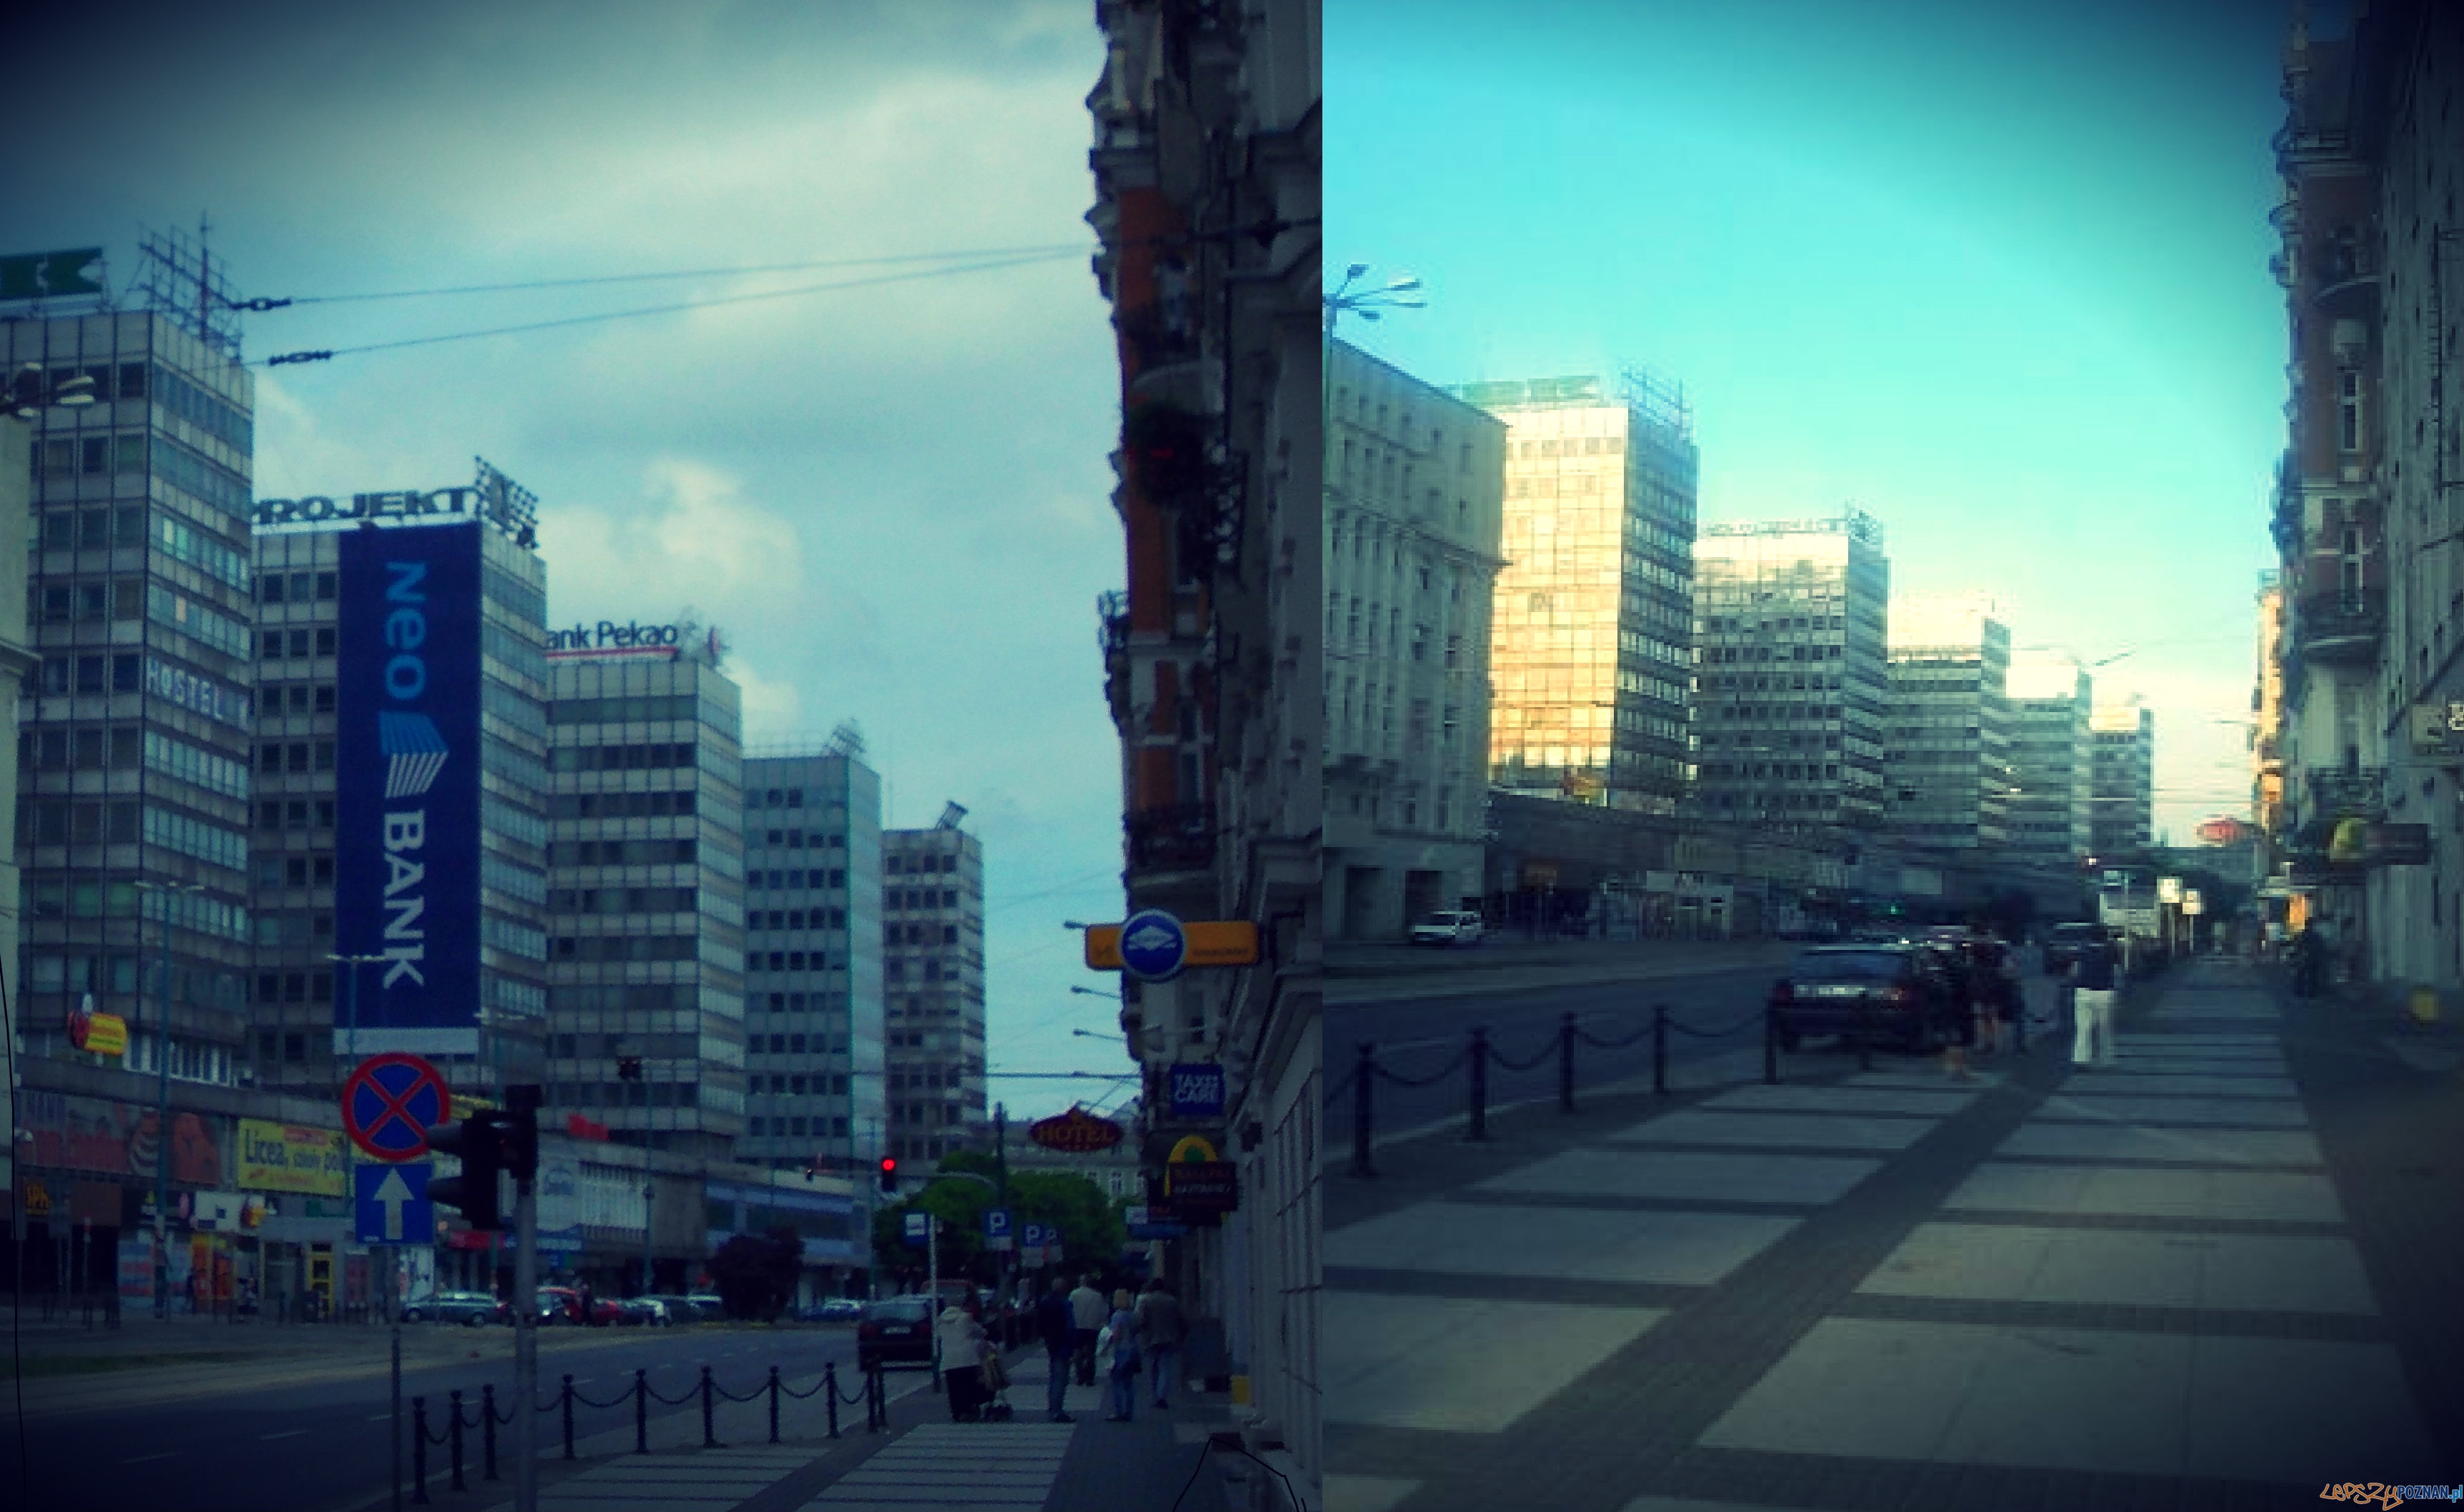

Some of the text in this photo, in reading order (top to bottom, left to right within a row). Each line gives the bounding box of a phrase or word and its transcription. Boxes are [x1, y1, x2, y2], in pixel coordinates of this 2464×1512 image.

[250, 486, 484, 525] ROJEKT
[597, 619, 678, 646] Pekao
[383, 808, 425, 990] BANK
[1038, 1124, 1115, 1143] HOTEL
[989, 1211, 1007, 1235] P
[1025, 1224, 1041, 1244] P
